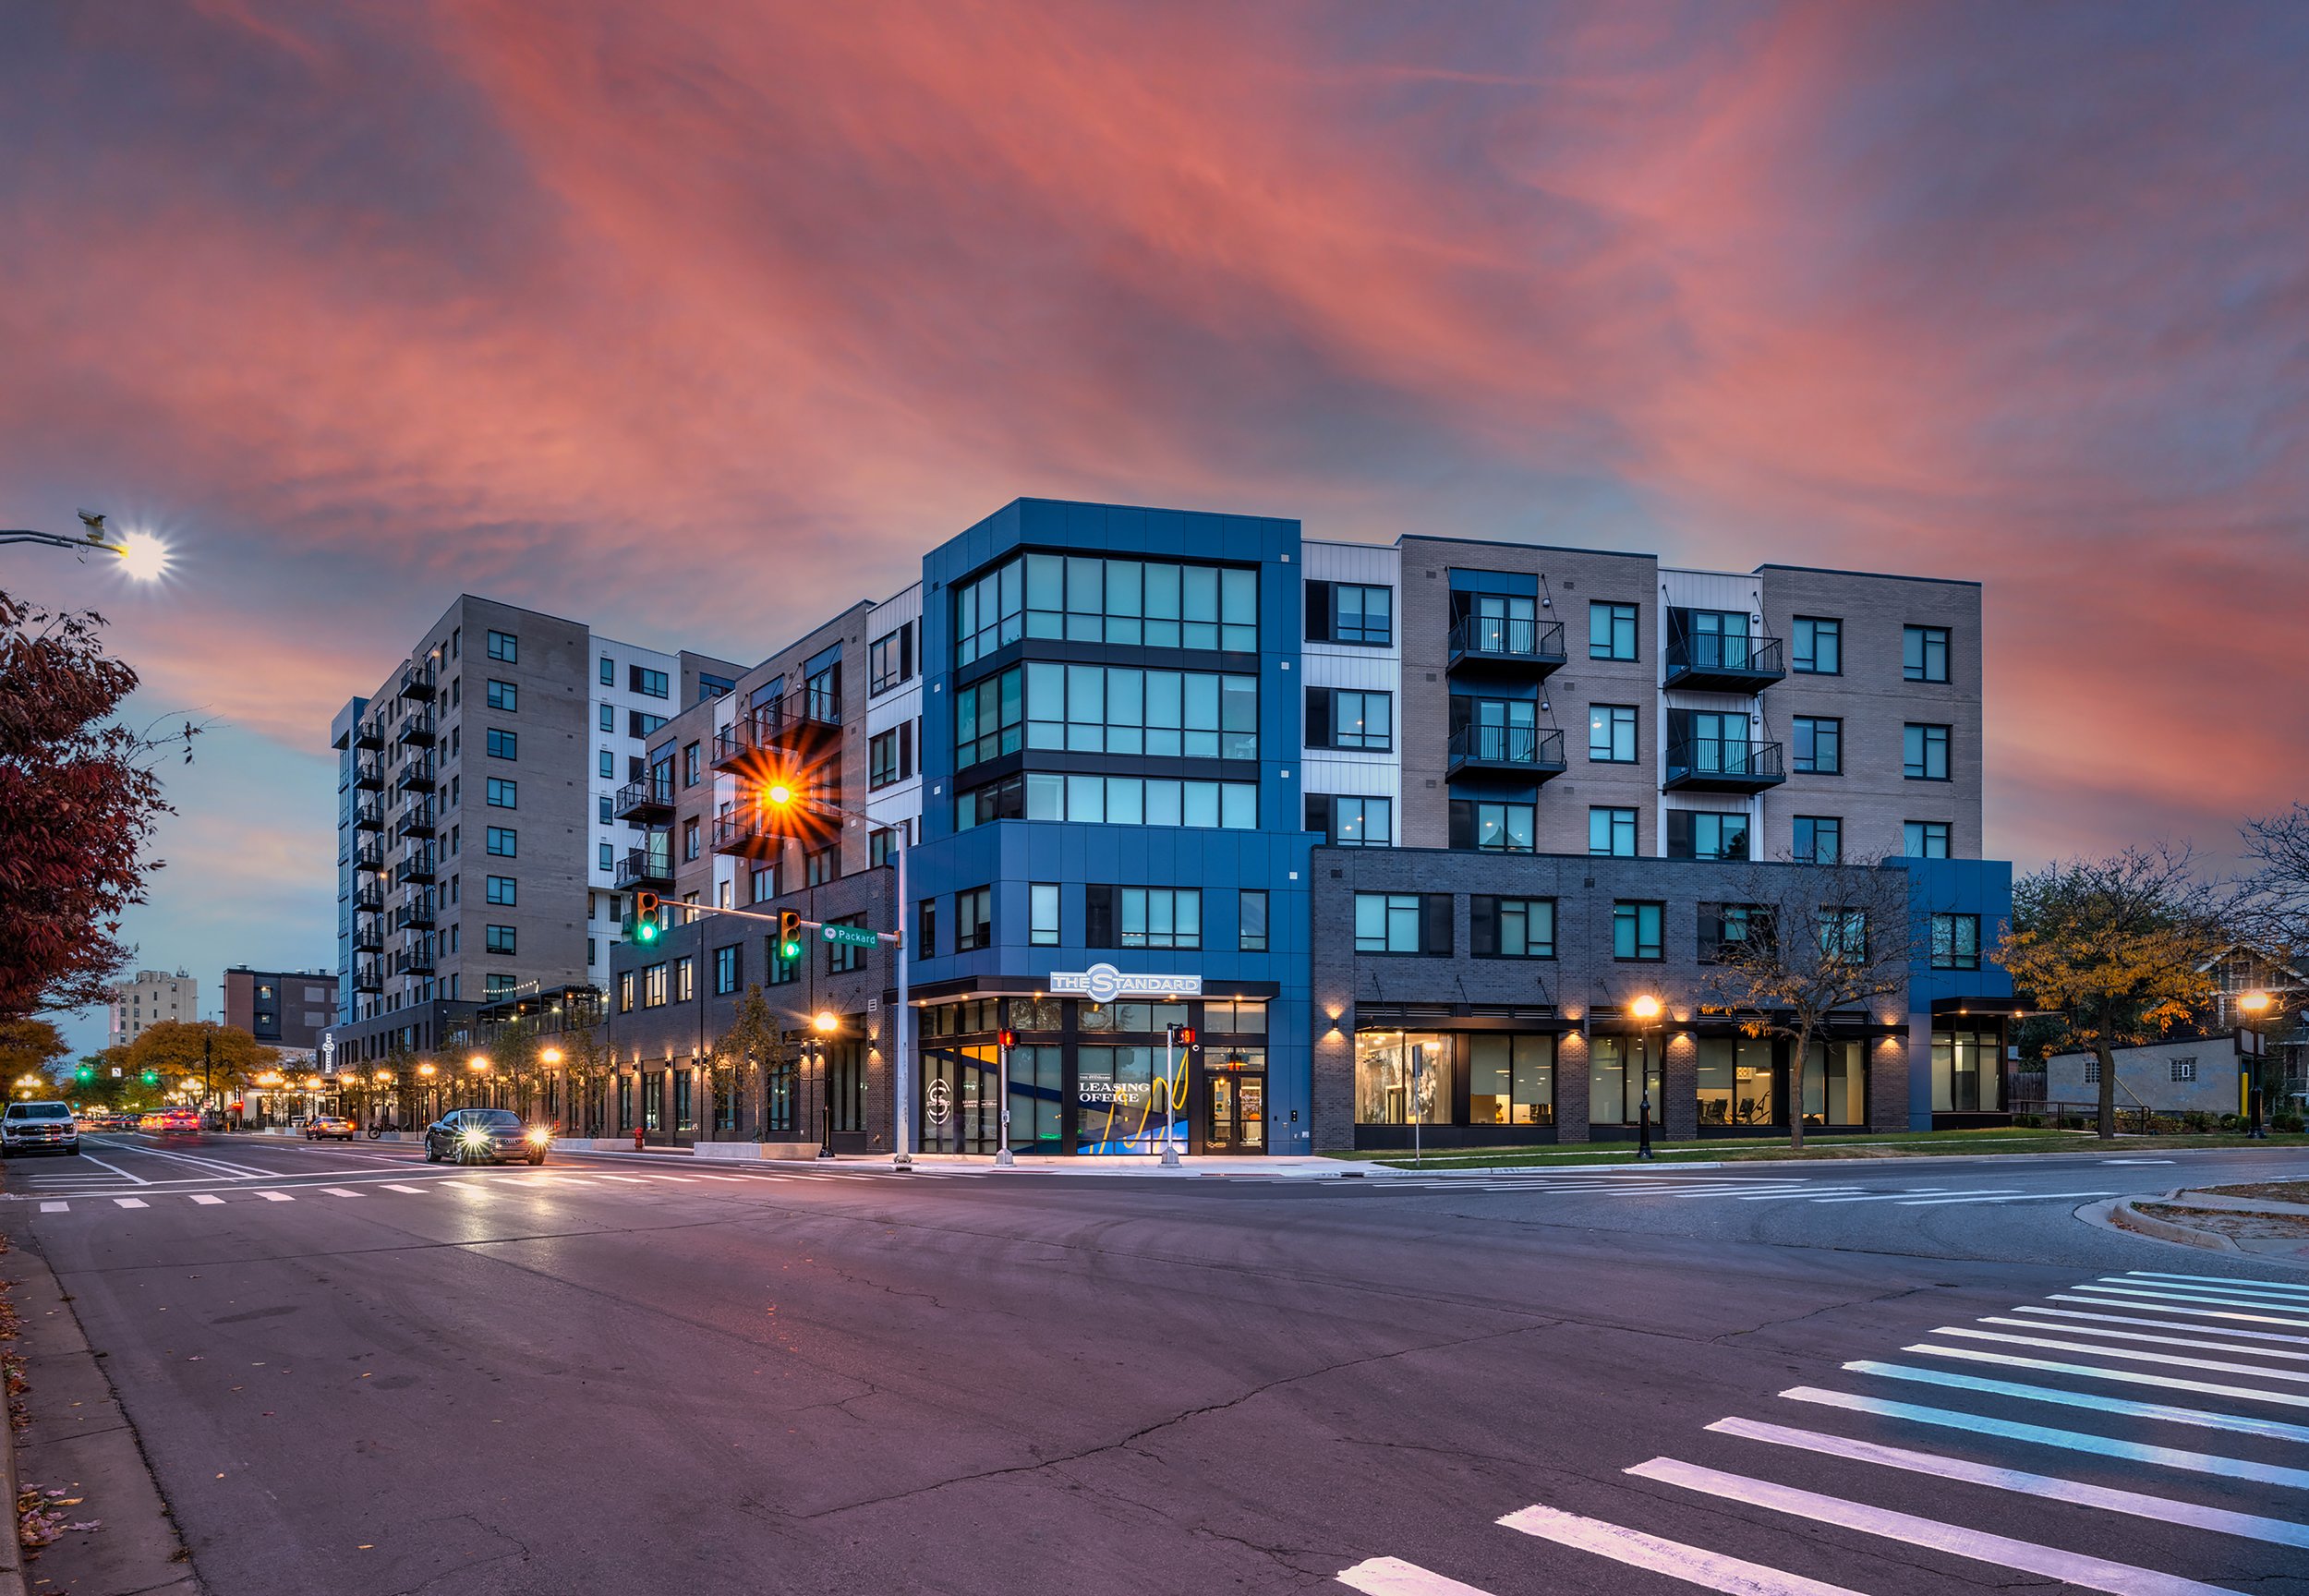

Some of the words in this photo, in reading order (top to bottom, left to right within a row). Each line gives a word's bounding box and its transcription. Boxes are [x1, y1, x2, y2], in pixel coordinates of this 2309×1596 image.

[839, 930, 876, 944] Packard
[1053, 976, 1091, 988] THE
[1092, 973, 1199, 992] STANDARD
[1079, 1082, 1151, 1093] LEASING
[1079, 1093, 1140, 1103] OFFICE
